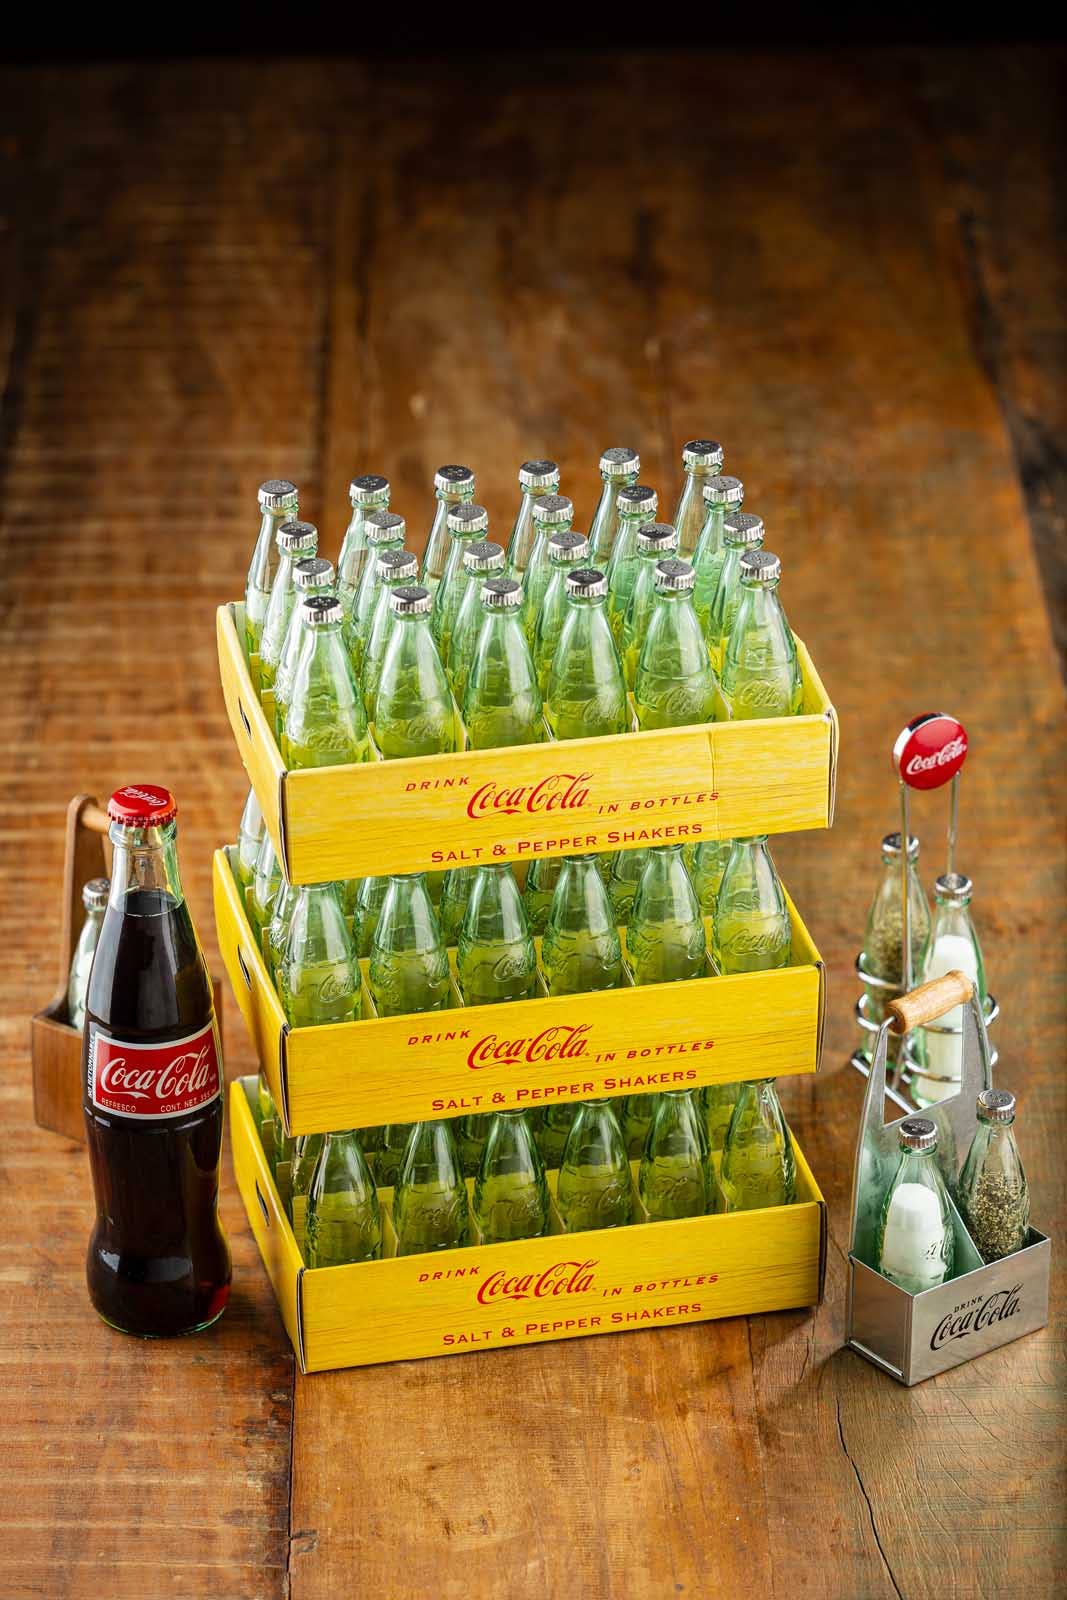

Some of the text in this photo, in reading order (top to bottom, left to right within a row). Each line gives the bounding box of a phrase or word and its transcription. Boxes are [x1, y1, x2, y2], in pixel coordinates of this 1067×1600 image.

[905, 734, 967, 775] Coca-Cola
[405, 771, 720, 819] DRINK Coca-Cola IN BOTTLES
[492, 844, 507, 856] &
[407, 1023, 716, 1070] DRINK Coca-Cola IN BOTTLES
[100, 1045, 211, 1099] Coca-Cola
[101, 1097, 137, 1113] REFRESCO
[491, 1092, 506, 1104] &
[418, 1258, 720, 1305] DRINK Coca-Cola IN BOTTLES
[929, 1281, 1025, 1351] Coca-Cola
[953, 1295, 983, 1313] DRINK
[501, 1327, 515, 1338] &
